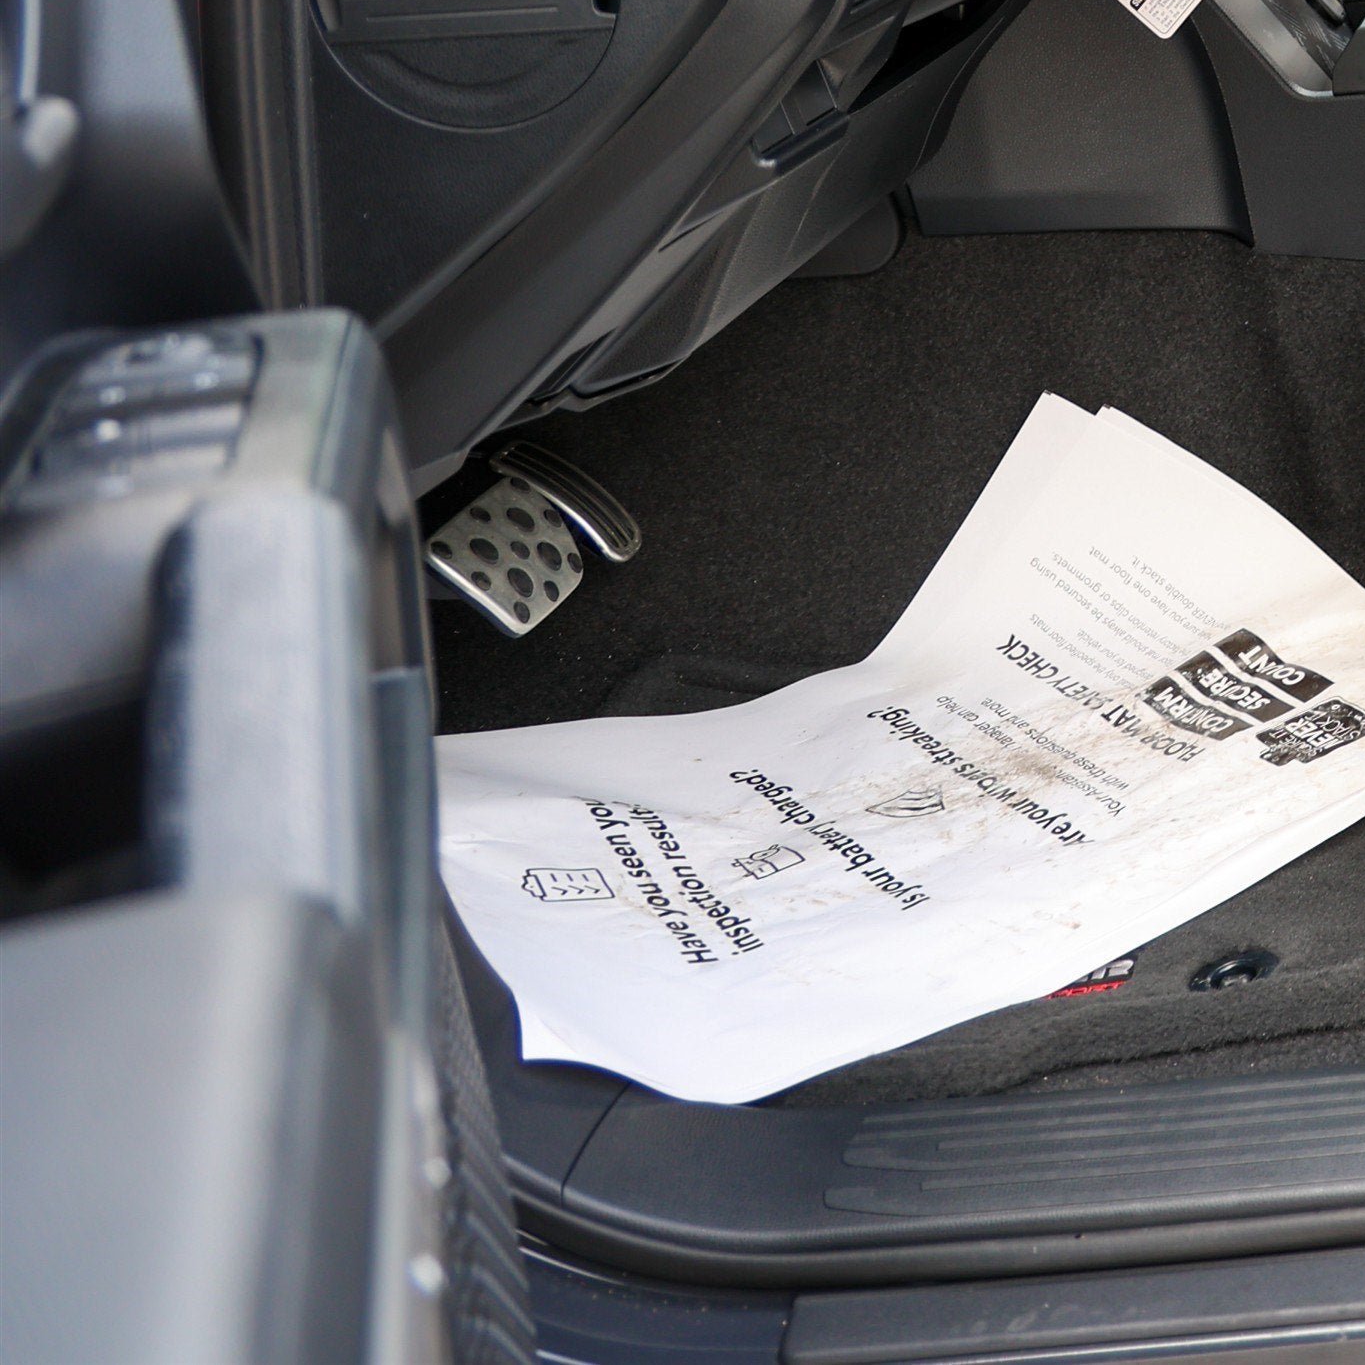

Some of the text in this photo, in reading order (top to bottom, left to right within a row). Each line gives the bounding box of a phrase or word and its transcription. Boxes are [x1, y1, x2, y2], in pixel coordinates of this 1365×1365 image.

[1089, 545, 1110, 564] mat
[1028, 556, 1056, 581] using
[1049, 551, 1101, 592] grommets.
[1109, 562, 1133, 585] floor
[1139, 562, 1166, 584] stack
[1053, 578, 1091, 609] secured
[1099, 590, 1110, 601] or
[1132, 580, 1151, 597] one
[1163, 583, 1195, 610] double
[1090, 606, 1103, 621] be
[1109, 599, 1128, 618] clips
[1150, 594, 1170, 616] have
[1189, 605, 1218, 627] NEVER
[1029, 613, 1050, 631] mats
[1101, 615, 1128, 636] always
[1126, 613, 1159, 639] retention
[1168, 610, 1188, 623] you
[1181, 620, 1200, 634] sure
[1046, 629, 1068, 648] floor
[1120, 631, 1149, 653] should
[1060, 642, 1097, 665] specified
[1099, 645, 1119, 659] your
[1092, 662, 1105, 673] the
[1237, 645, 1306, 686] COUNT
[995, 633, 1205, 763] FLOOR MAT SAFETY CHECK
[1198, 667, 1270, 711] SECURE
[935, 696, 963, 713] help
[956, 706, 979, 723] can
[1152, 685, 1234, 734] CONFIRM
[1003, 713, 1029, 730] and
[1315, 715, 1360, 741] STACK
[866, 703, 961, 770] streaking?
[1024, 727, 1076, 759] questions
[1268, 728, 1287, 739] IT
[1284, 717, 1343, 752] NEVER
[1072, 755, 1105, 780] these
[1100, 772, 1129, 791] with
[1007, 796, 1067, 828] your
[1096, 795, 1125, 815] Your
[729, 769, 929, 909] Is your battery charged?
[1051, 820, 1093, 845] Are
[579, 797, 718, 963] Have you seen you
[612, 801, 764, 954] inspection result
